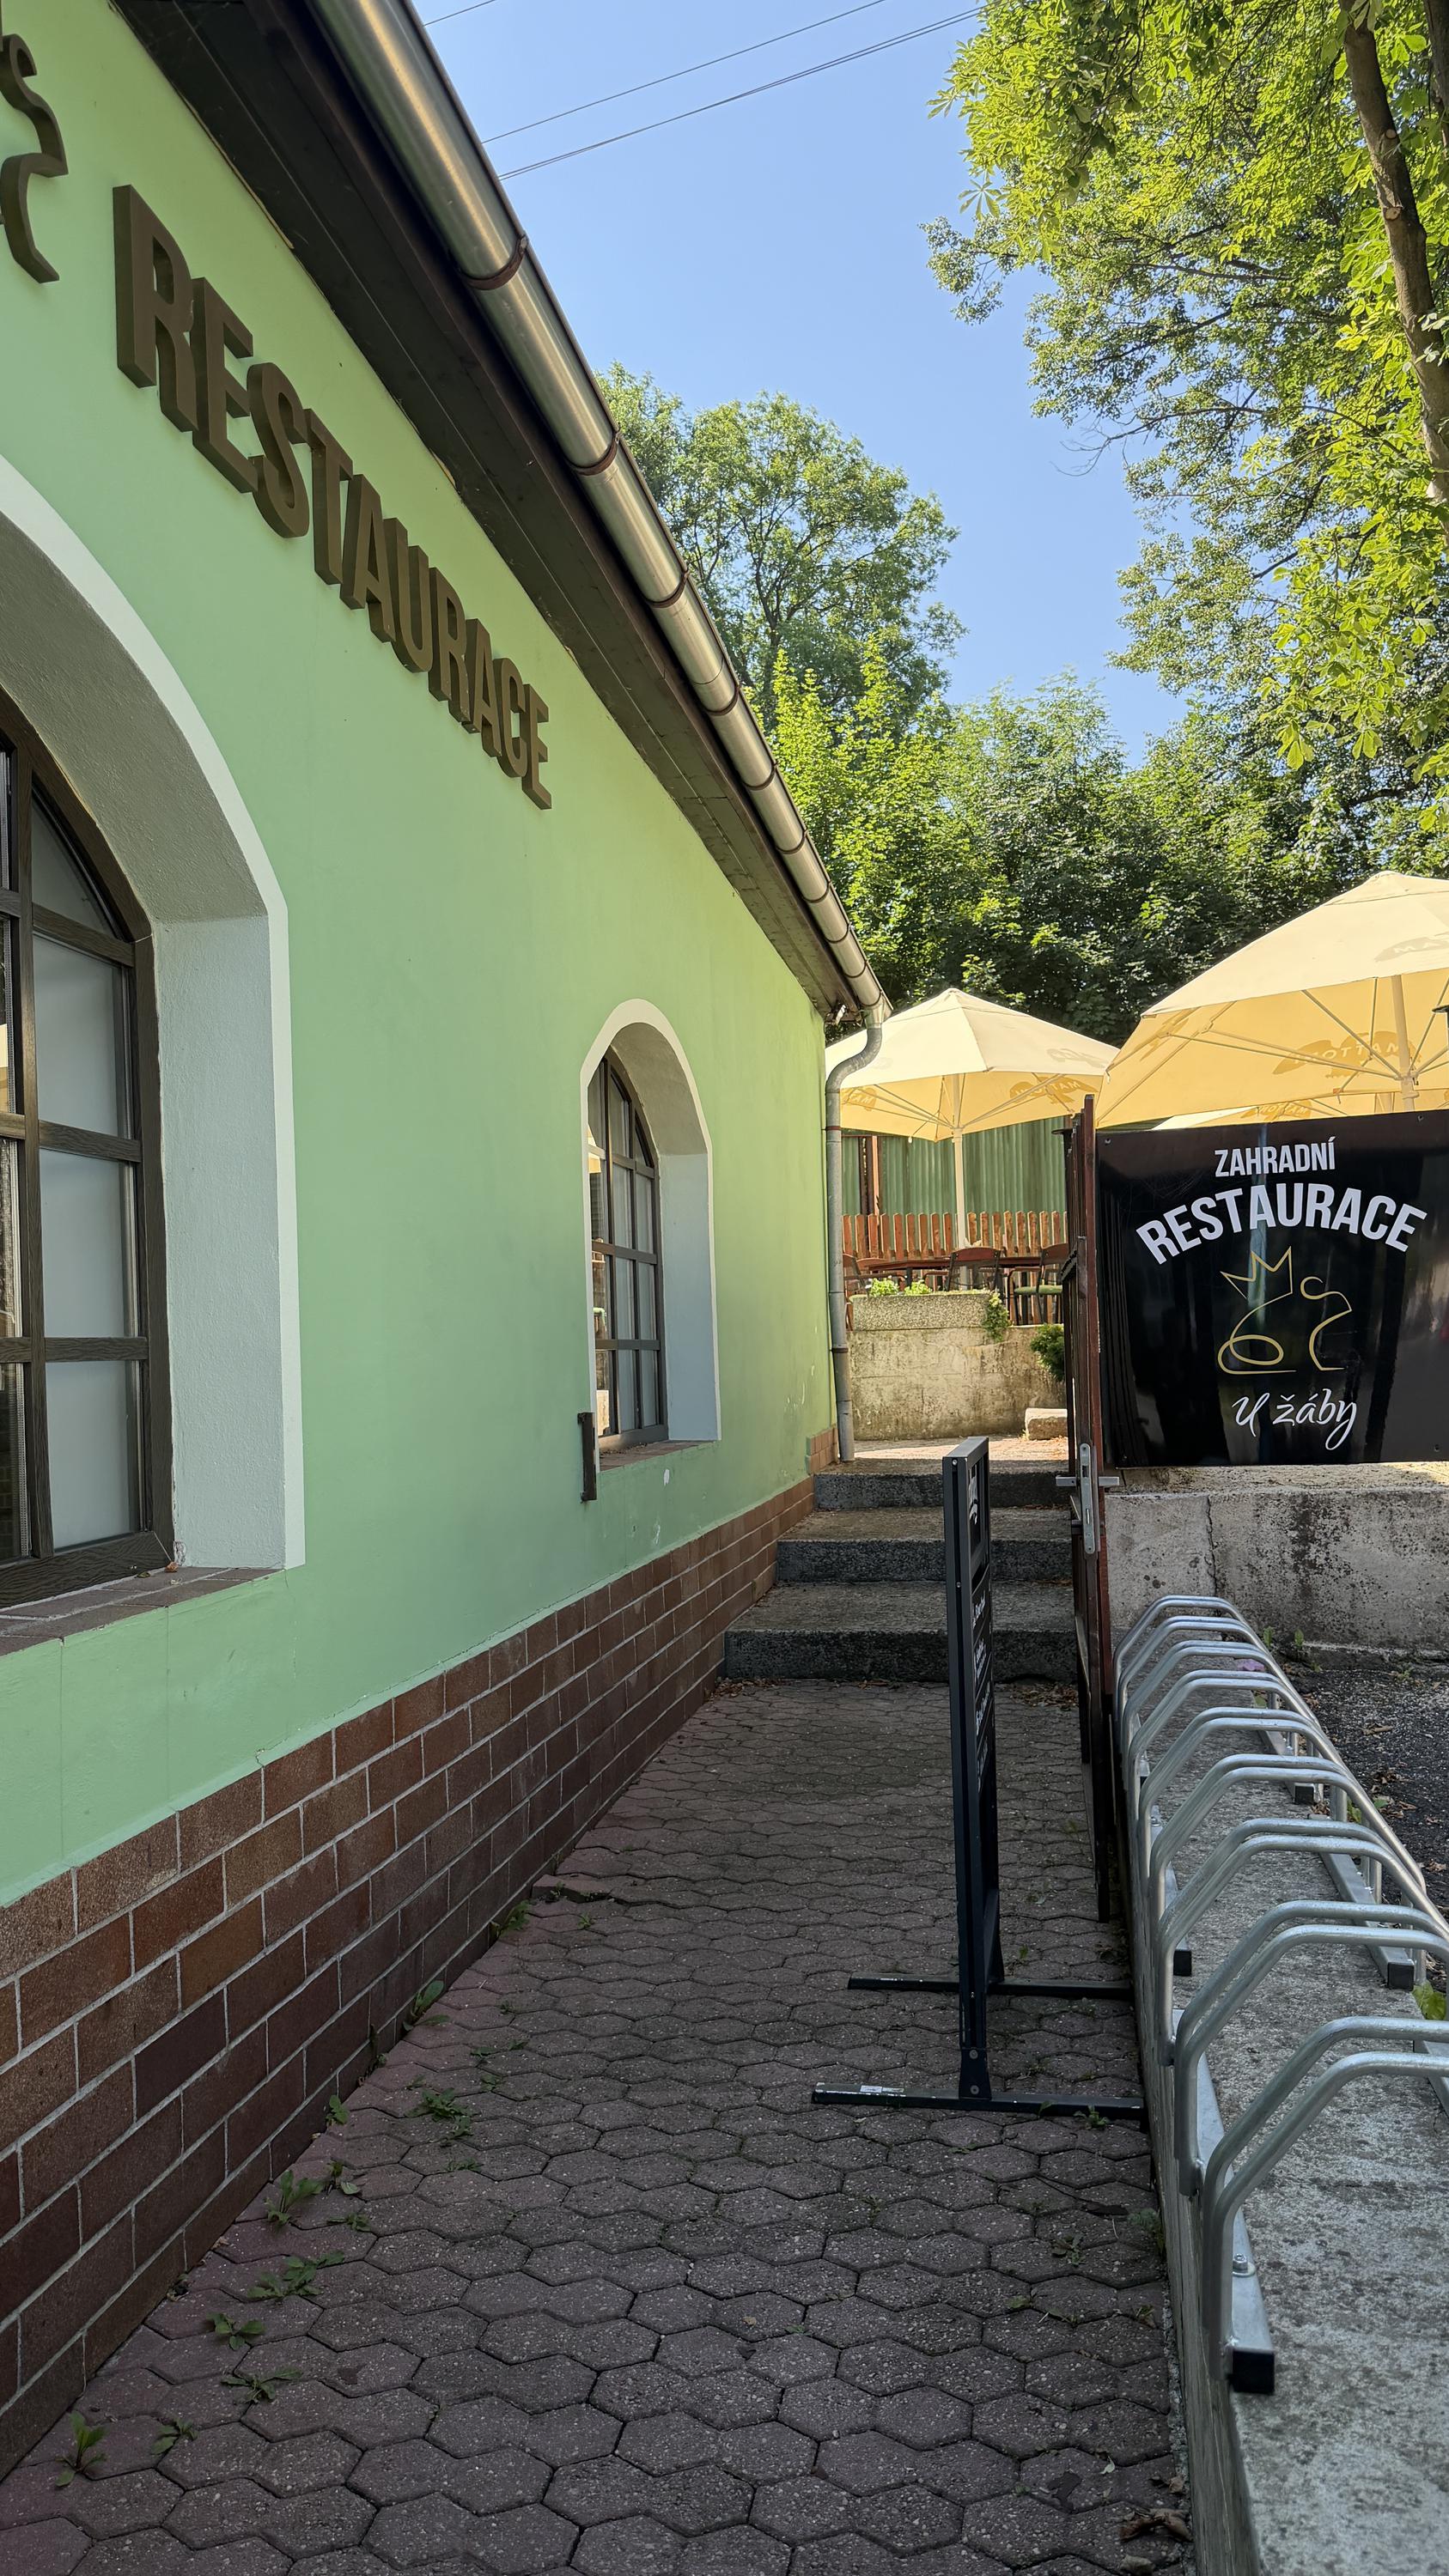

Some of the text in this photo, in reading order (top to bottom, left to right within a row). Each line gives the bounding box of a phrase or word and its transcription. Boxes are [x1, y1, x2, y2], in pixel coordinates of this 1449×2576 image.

[113, 184, 553, 810] RESTAURACE
[1215, 1136, 1336, 1177] ZAHRADNÍ
[1135, 1182, 1428, 1265] RESTAURACE
[1272, 1388, 1358, 1450] žáby
